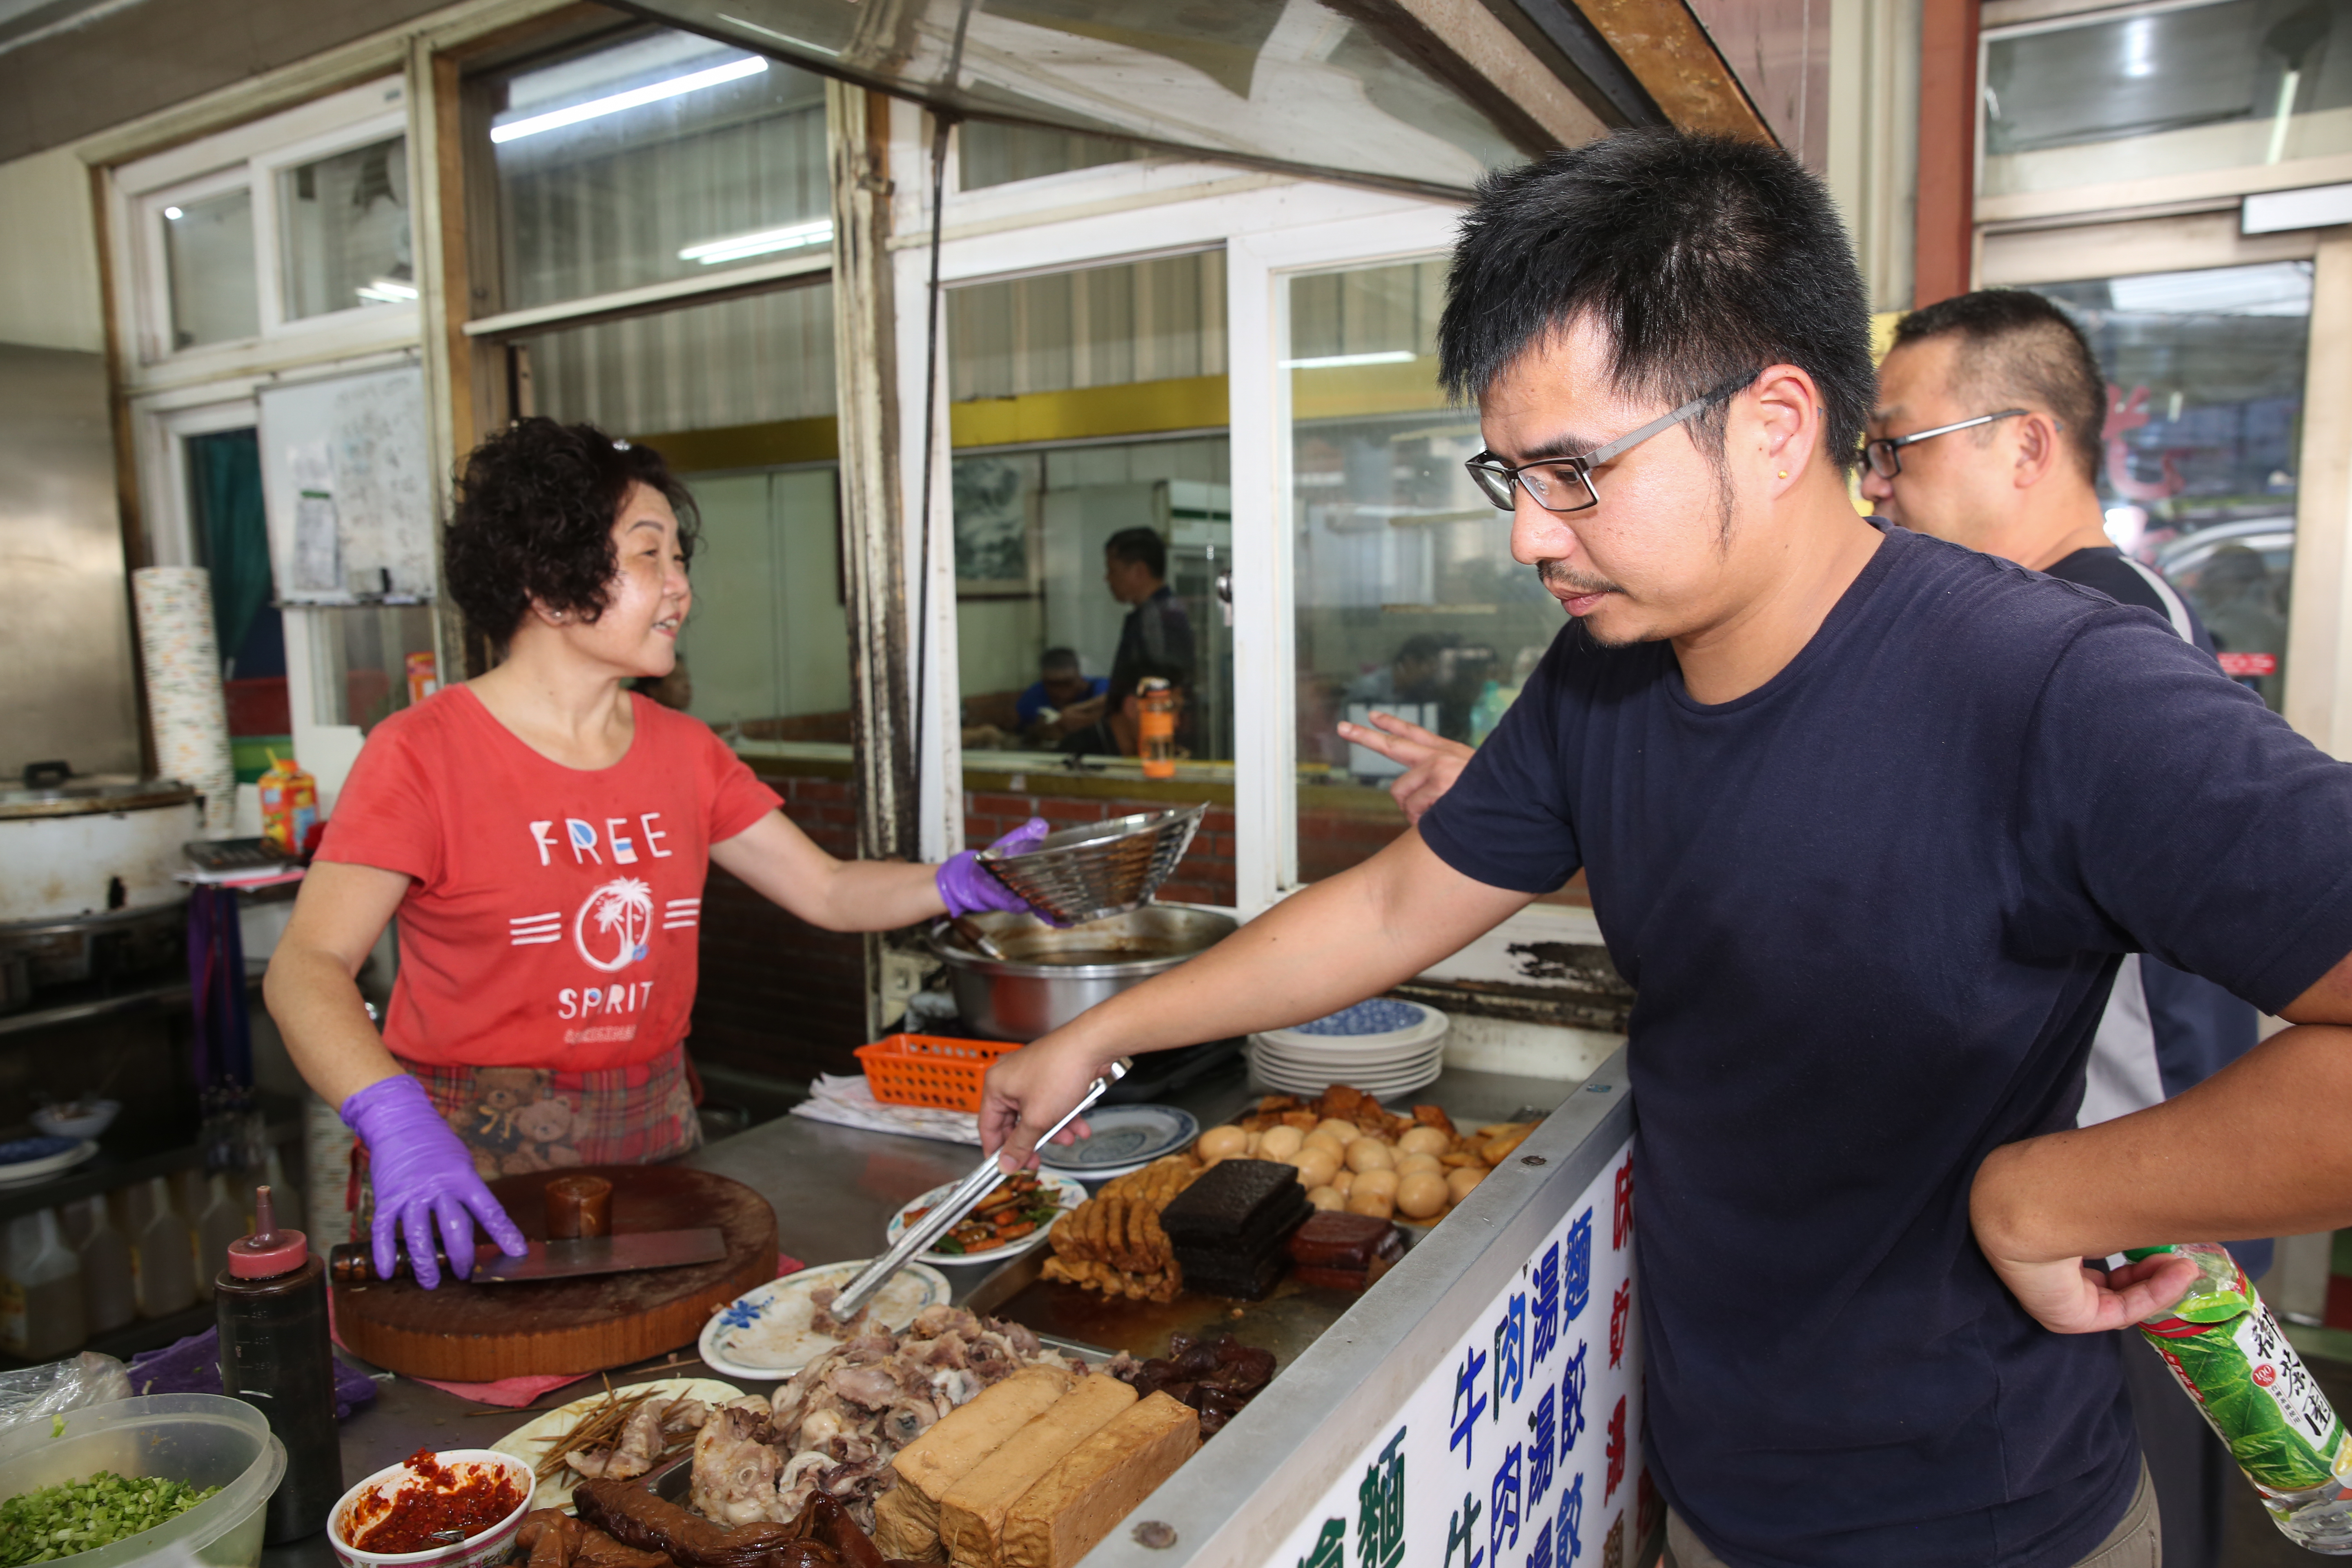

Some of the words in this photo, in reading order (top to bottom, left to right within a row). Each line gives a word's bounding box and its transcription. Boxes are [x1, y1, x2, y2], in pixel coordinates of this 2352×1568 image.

[530, 812, 673, 866] FREE
[1450, 1206, 1592, 1470] 牛肉湯麵
[2252, 1306, 2332, 1437] 御茶園
